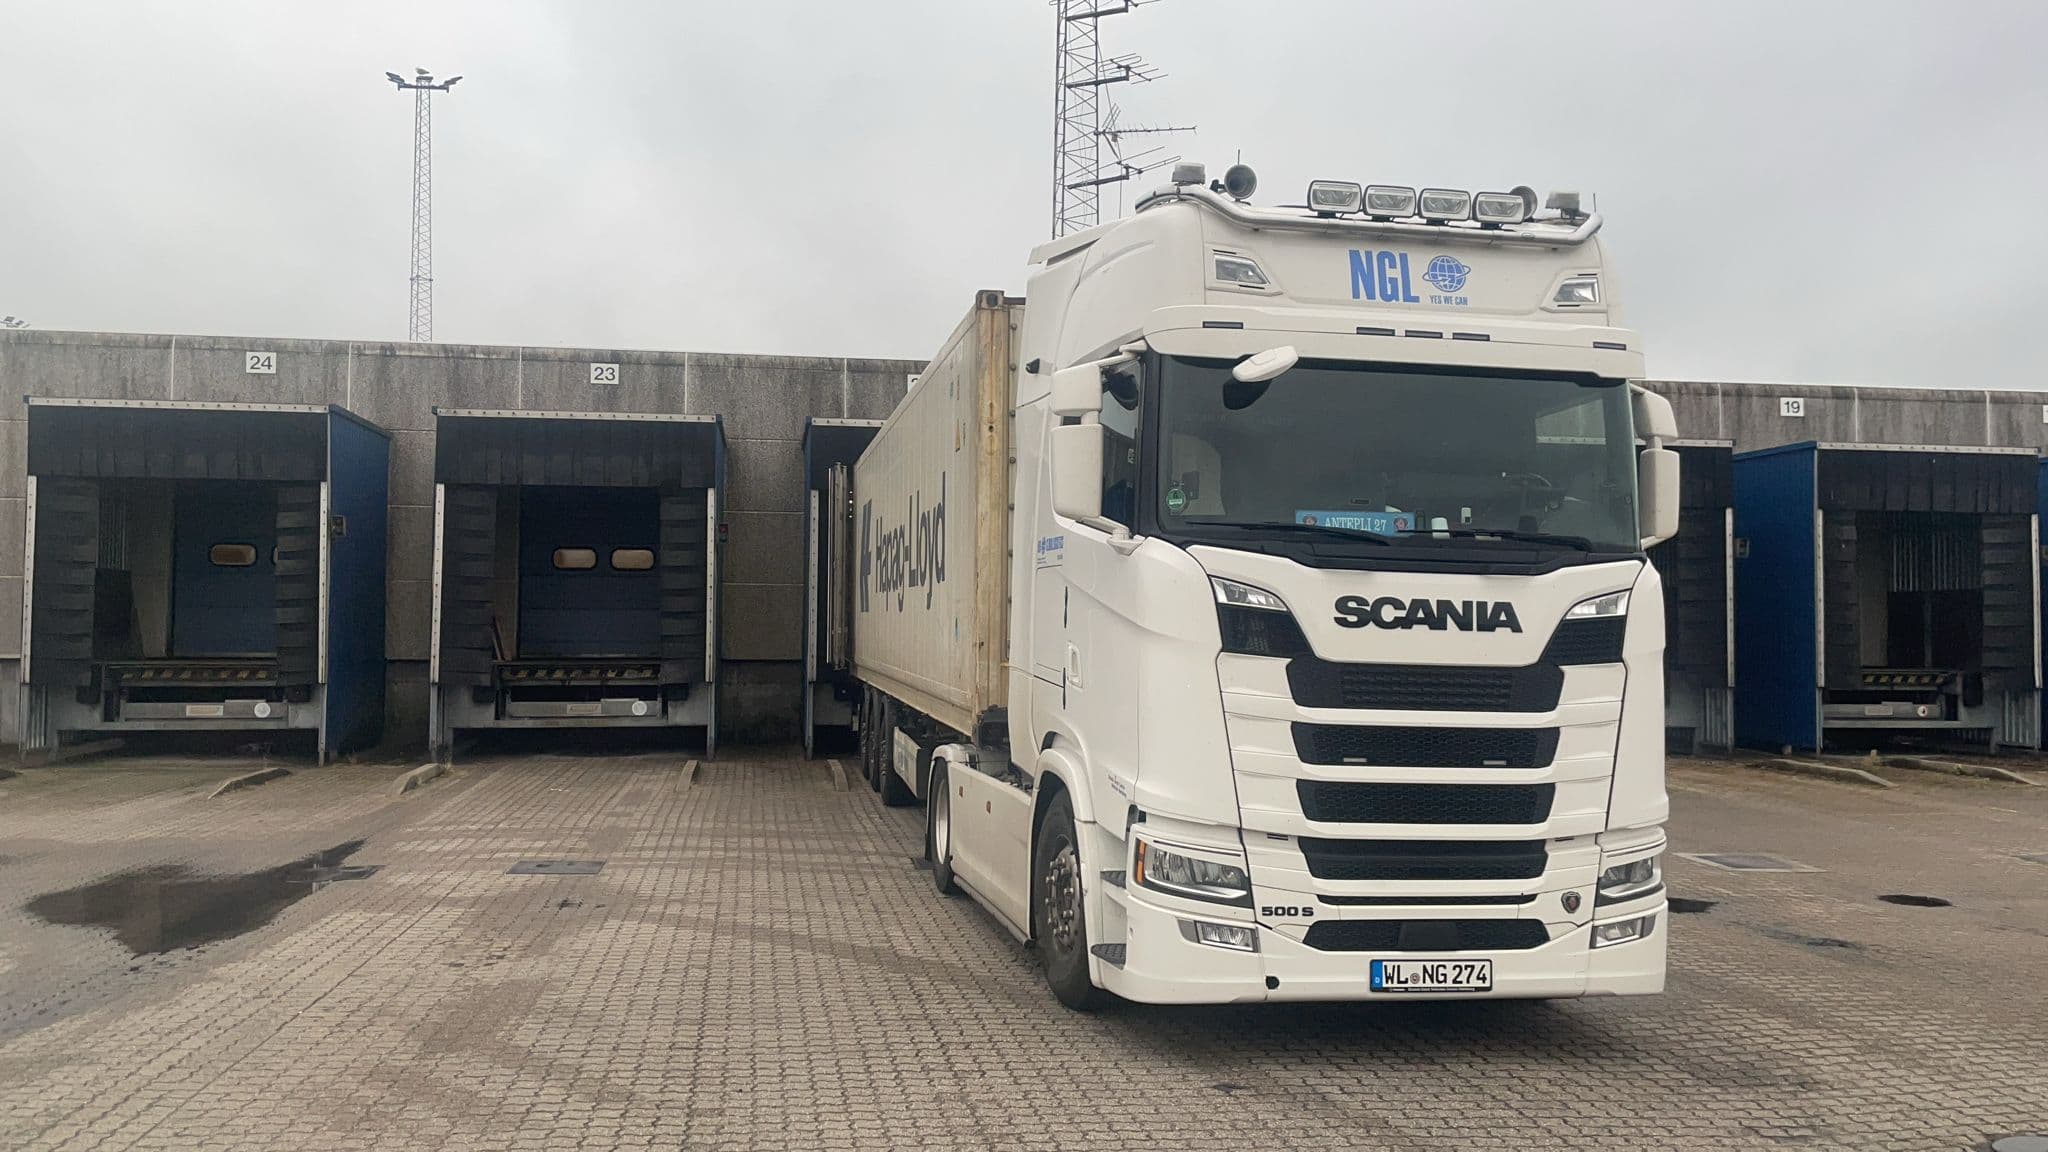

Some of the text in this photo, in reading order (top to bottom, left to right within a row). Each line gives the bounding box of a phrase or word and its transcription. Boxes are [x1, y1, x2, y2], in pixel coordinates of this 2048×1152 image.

[1348, 249, 1420, 303] NGL
[1429, 295, 1468, 306] YES WE CAN
[250, 355, 272, 370] 24
[594, 366, 616, 381] 23
[1784, 400, 1800, 414] 19
[1374, 518, 1387, 532] 27
[875, 471, 946, 613] Hapag-Lloyd
[1333, 595, 1523, 633] SCANIA
[1261, 906, 1314, 917] 500 S
[1384, 964, 1487, 985] WL NG 274
